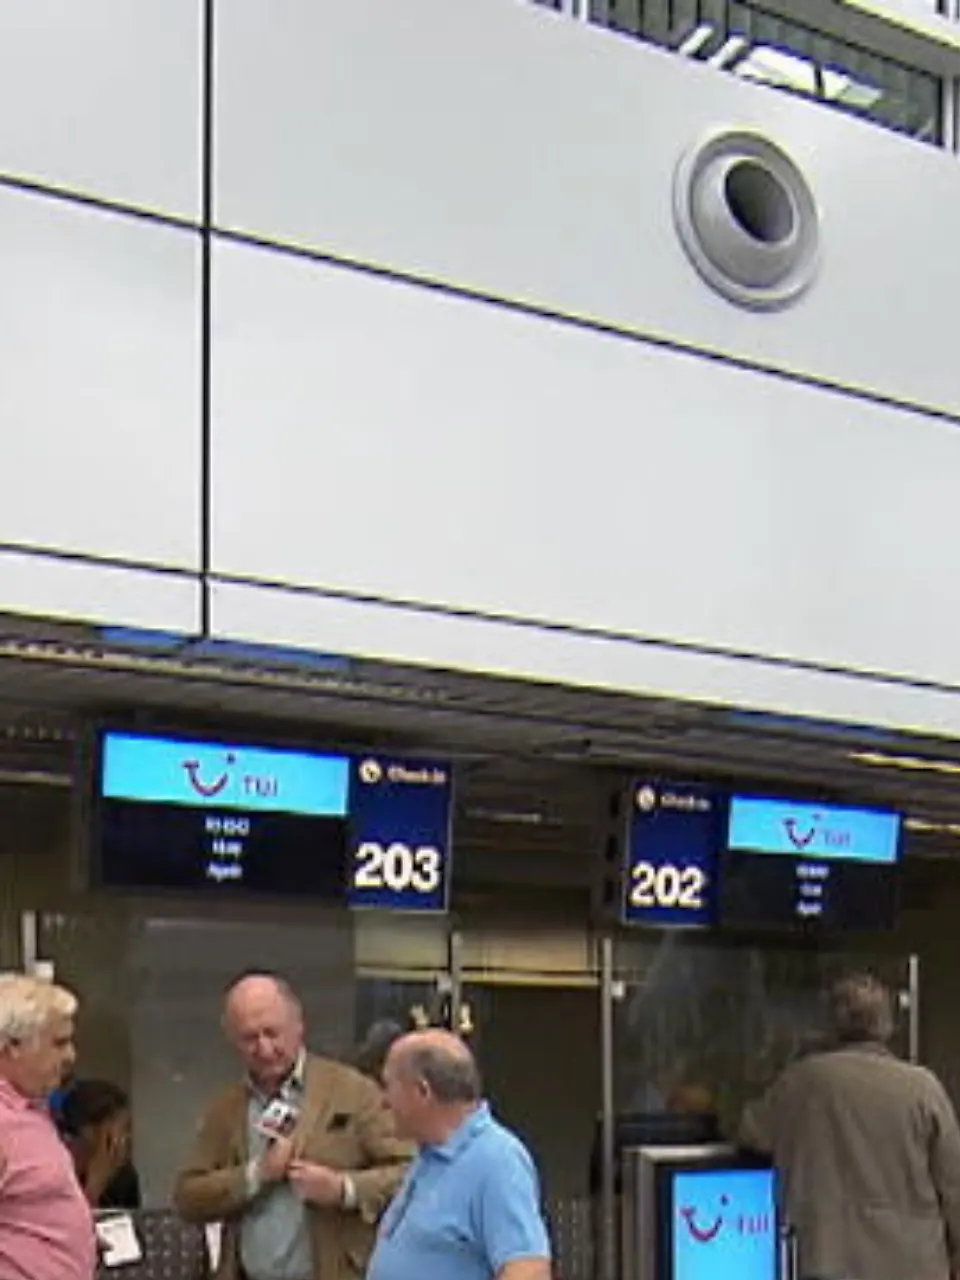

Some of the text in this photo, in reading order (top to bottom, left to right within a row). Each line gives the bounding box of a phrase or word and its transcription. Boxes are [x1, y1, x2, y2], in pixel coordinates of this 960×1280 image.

[244, 775, 278, 797] TUI
[354, 842, 440, 893] 203
[630, 861, 706, 909] 202
